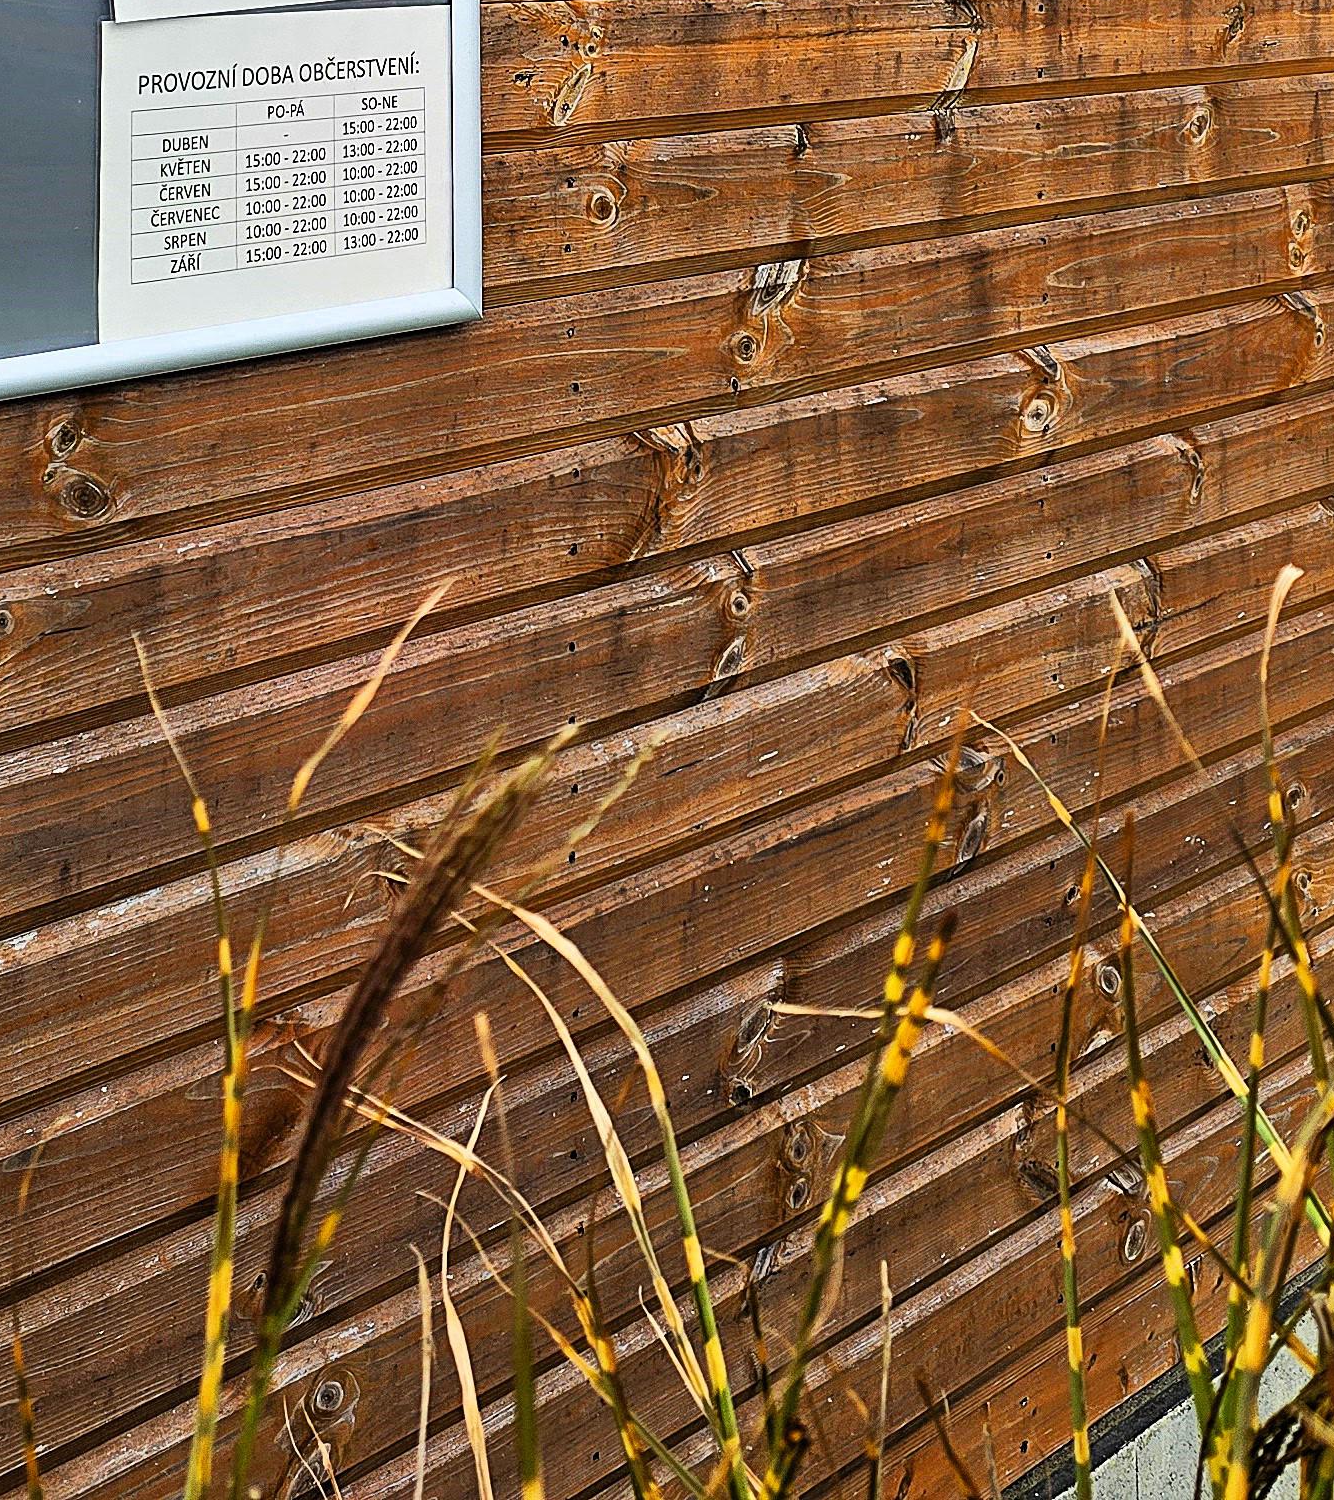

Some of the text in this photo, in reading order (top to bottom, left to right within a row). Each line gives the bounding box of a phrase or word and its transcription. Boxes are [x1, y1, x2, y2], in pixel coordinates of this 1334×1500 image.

[138, 51, 420, 95] PROVOZNÍ DOBA OBČERSTVENÍ:
[267, 96, 398, 120] PO-PÁ SO-NE
[162, 116, 417, 153] DUBEN 15:00 22:00
[160, 139, 417, 178] KVĚTEN 15:00 22:00 13:00 22:00
[159, 161, 418, 203] ČERVEN 15:00 22:00 10:00 22:00
[150, 182, 418, 228] ČERVENEC 10:00 22:00 10:00 22:00
[164, 205, 418, 251] SRPEN 10:00 22:00 10:00 22:00
[170, 227, 419, 274] ZÁŘÍ 15:00 22:00 13:00 22:00
